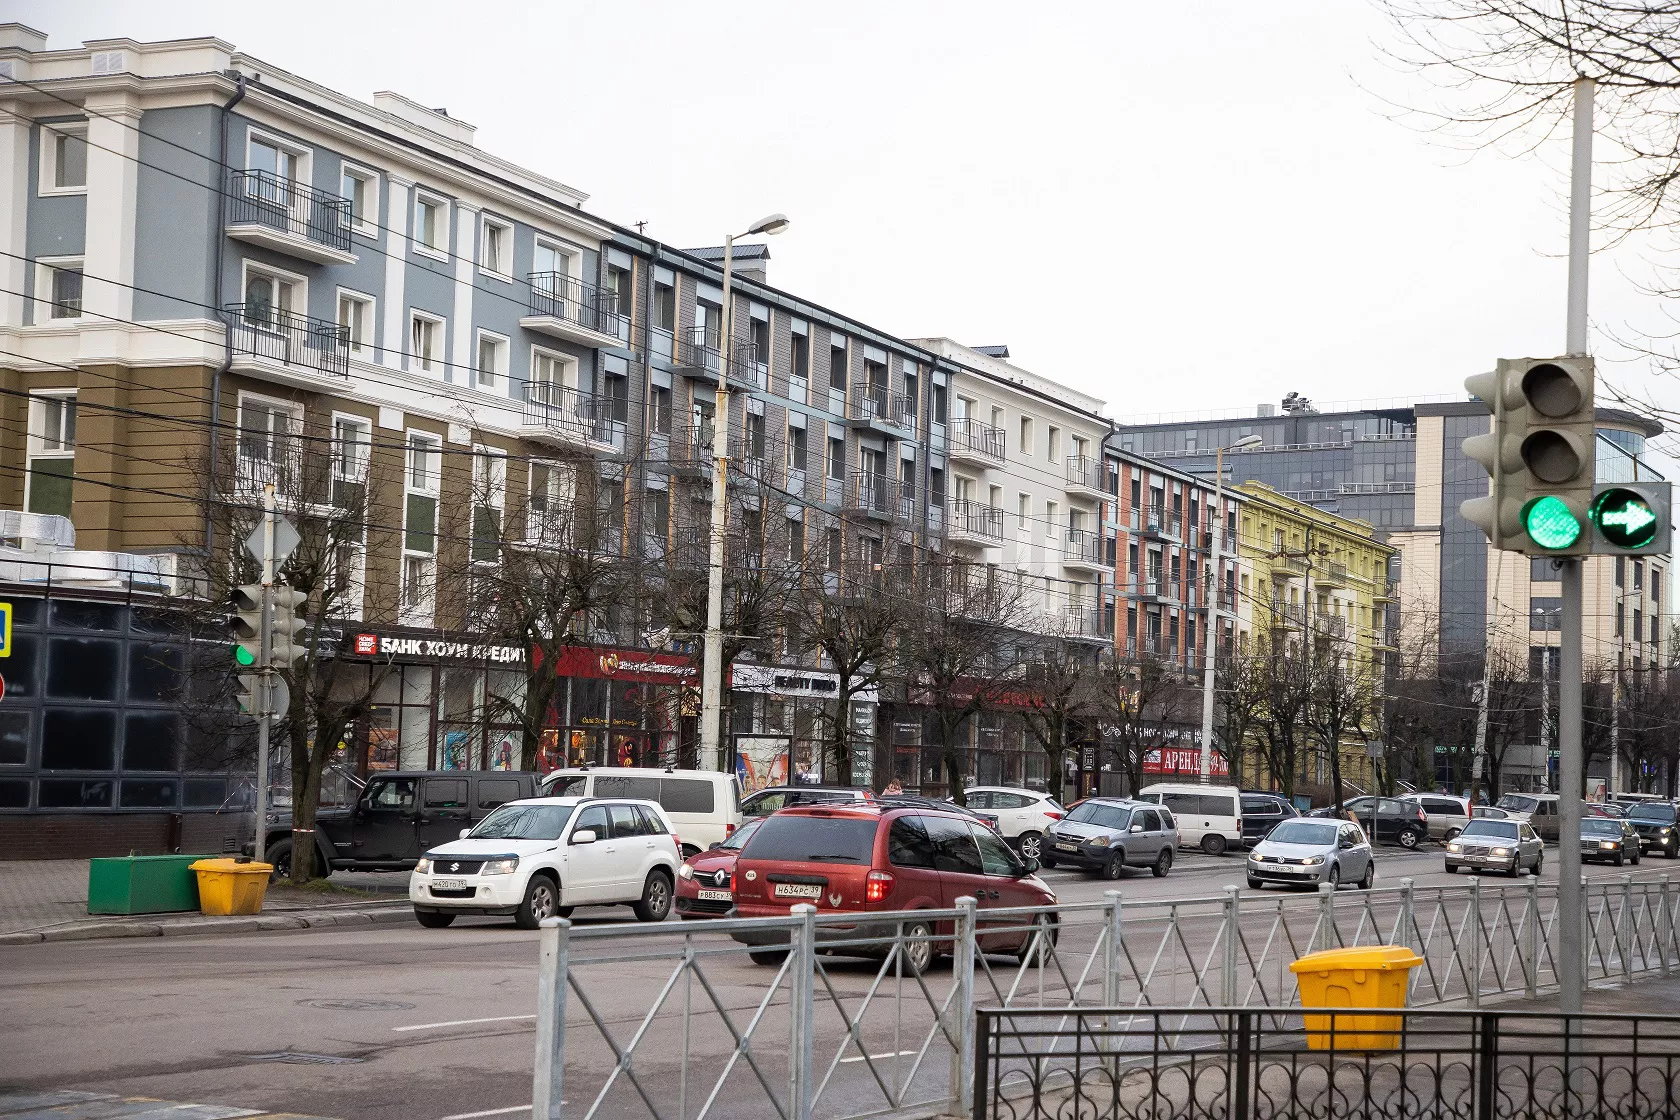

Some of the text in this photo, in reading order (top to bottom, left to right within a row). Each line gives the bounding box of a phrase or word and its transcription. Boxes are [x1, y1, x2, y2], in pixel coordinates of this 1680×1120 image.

[381, 637, 422, 655] БАНК
[425, 640, 469, 658] ХОУМ
[1164, 750, 1202, 775] АРЕНД
[778, 884, 819, 896] Н634РС 39
